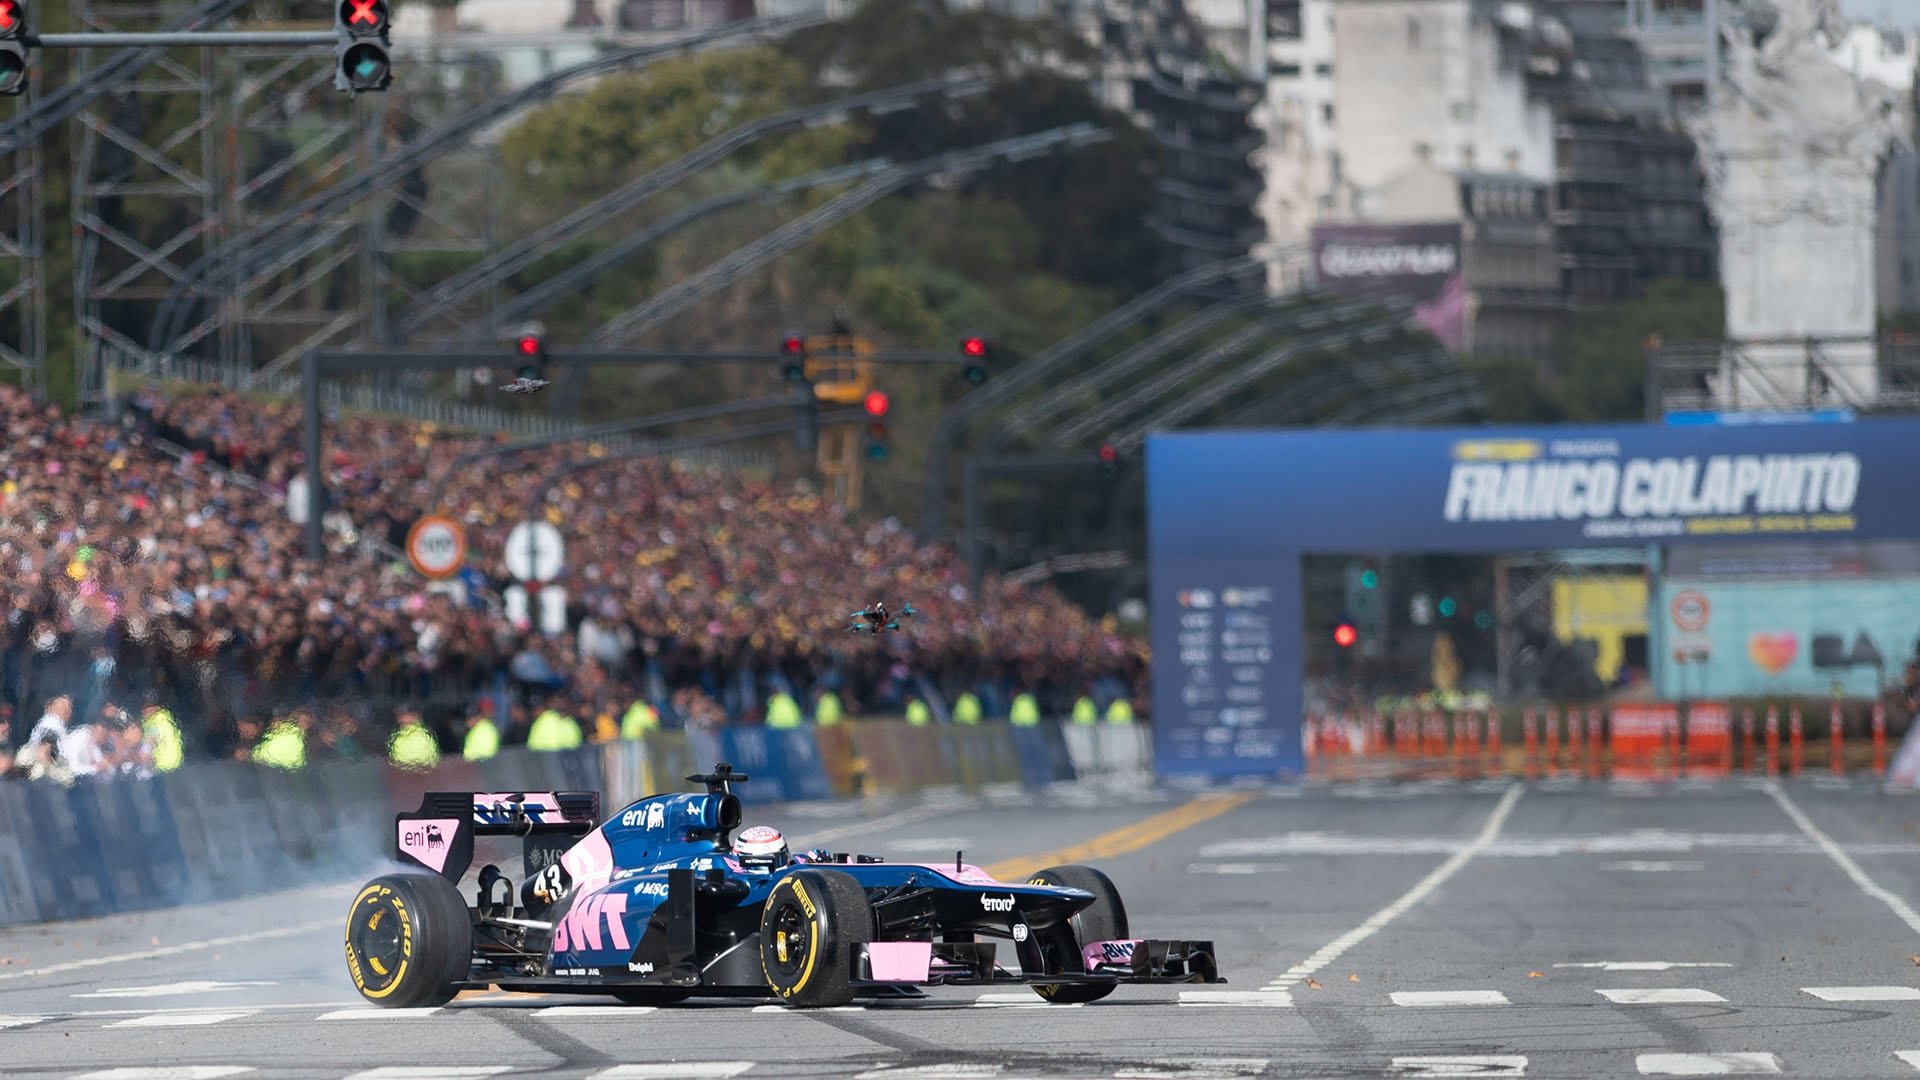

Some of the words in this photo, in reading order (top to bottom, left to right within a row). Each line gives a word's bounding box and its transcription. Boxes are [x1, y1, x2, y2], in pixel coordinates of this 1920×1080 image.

[1444, 459, 1621, 521] FRANCO
[1618, 452, 1861, 516] COLAPINTO
[622, 804, 648, 827] eni
[405, 827, 424, 847] eni
[543, 849, 563, 866] MS
[534, 864, 568, 902] 43
[642, 882, 669, 896] MSC
[392, 896, 411, 957] ZERO
